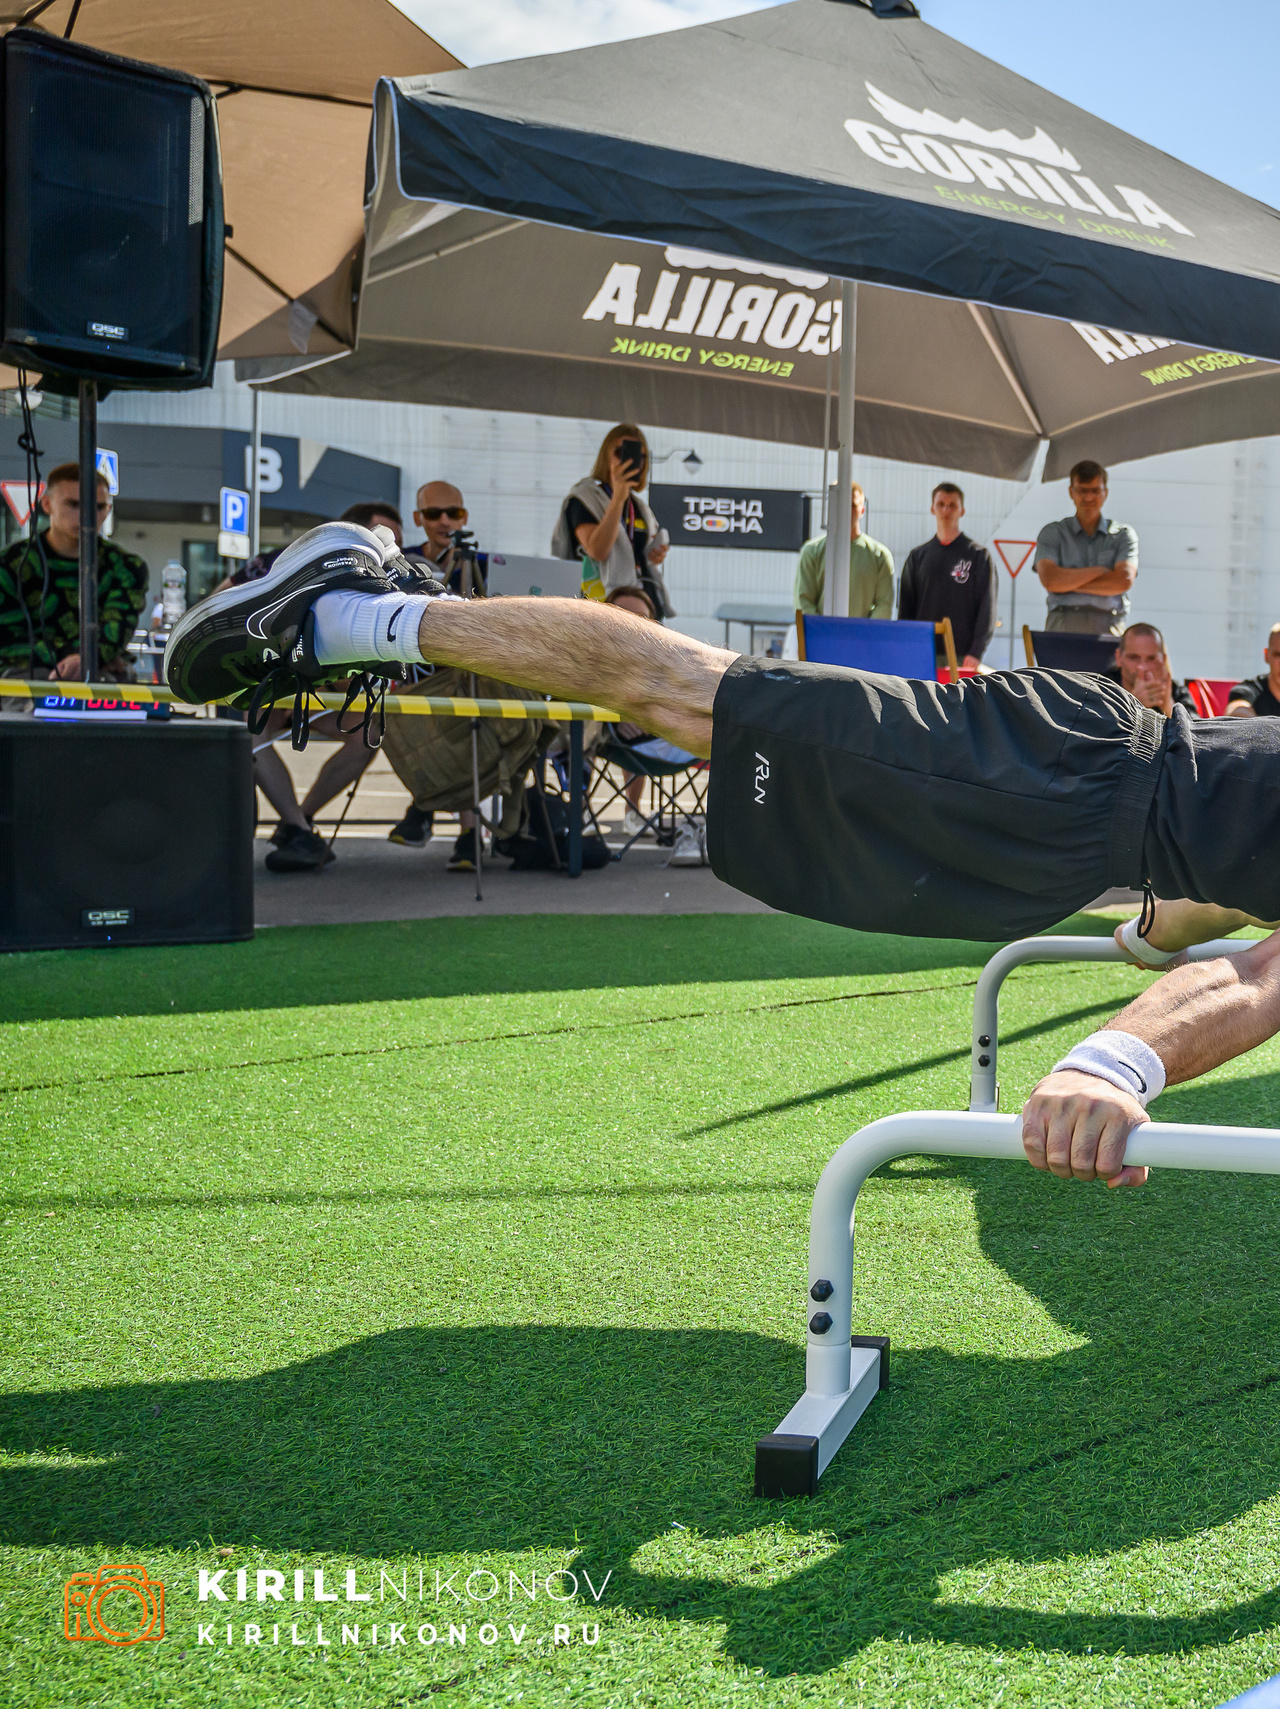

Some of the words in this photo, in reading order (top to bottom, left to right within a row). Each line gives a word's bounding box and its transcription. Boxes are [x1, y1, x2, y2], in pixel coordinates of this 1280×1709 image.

[844, 118, 1196, 238] GORILLA
[933, 185, 1068, 226] ENERGY
[1077, 217, 1178, 251] DRINK
[91, 322, 125, 337] QSC
[226, 495, 244, 529] P
[682, 496, 764, 518] ТРЕНД
[682, 513, 764, 534] ЗОНА
[88, 909, 130, 921] QSC
